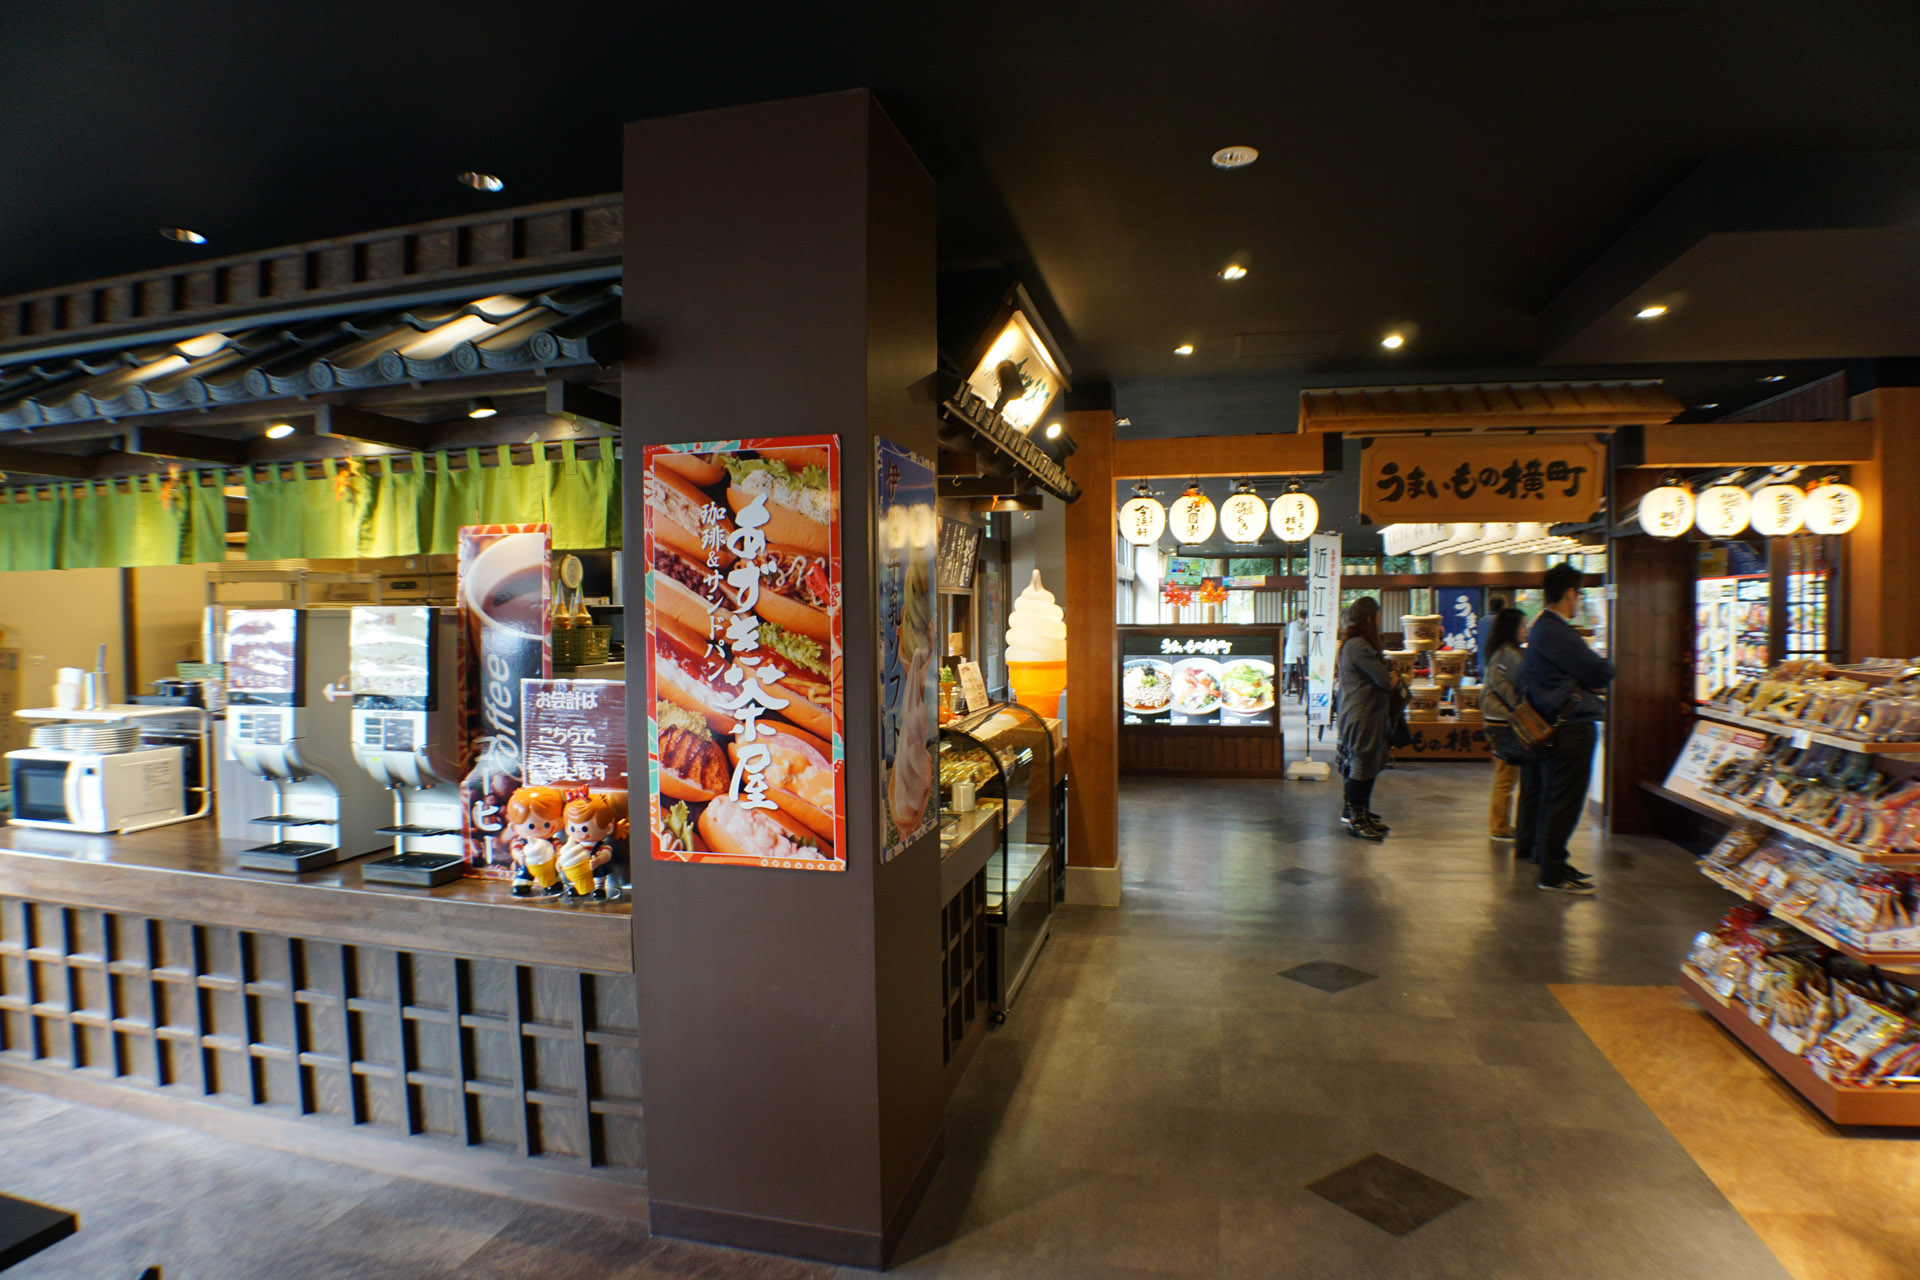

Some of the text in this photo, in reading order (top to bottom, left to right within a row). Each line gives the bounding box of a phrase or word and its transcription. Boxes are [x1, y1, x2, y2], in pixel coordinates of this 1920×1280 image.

[1377, 459, 1588, 503] うまいもの横町
[700, 502, 727, 683] 珈琲&サンドパン
[714, 493, 790, 811] あずき茶屋
[885, 460, 902, 754] 伊牛乳ソフト
[1160, 638, 1233, 655] うまいもの横町
[1310, 547, 1328, 657] 近江米
[486, 653, 523, 783] Coffee
[535, 690, 599, 710] お会計は
[538, 726, 597, 746] こちらで
[471, 735, 503, 865] コーヒー
